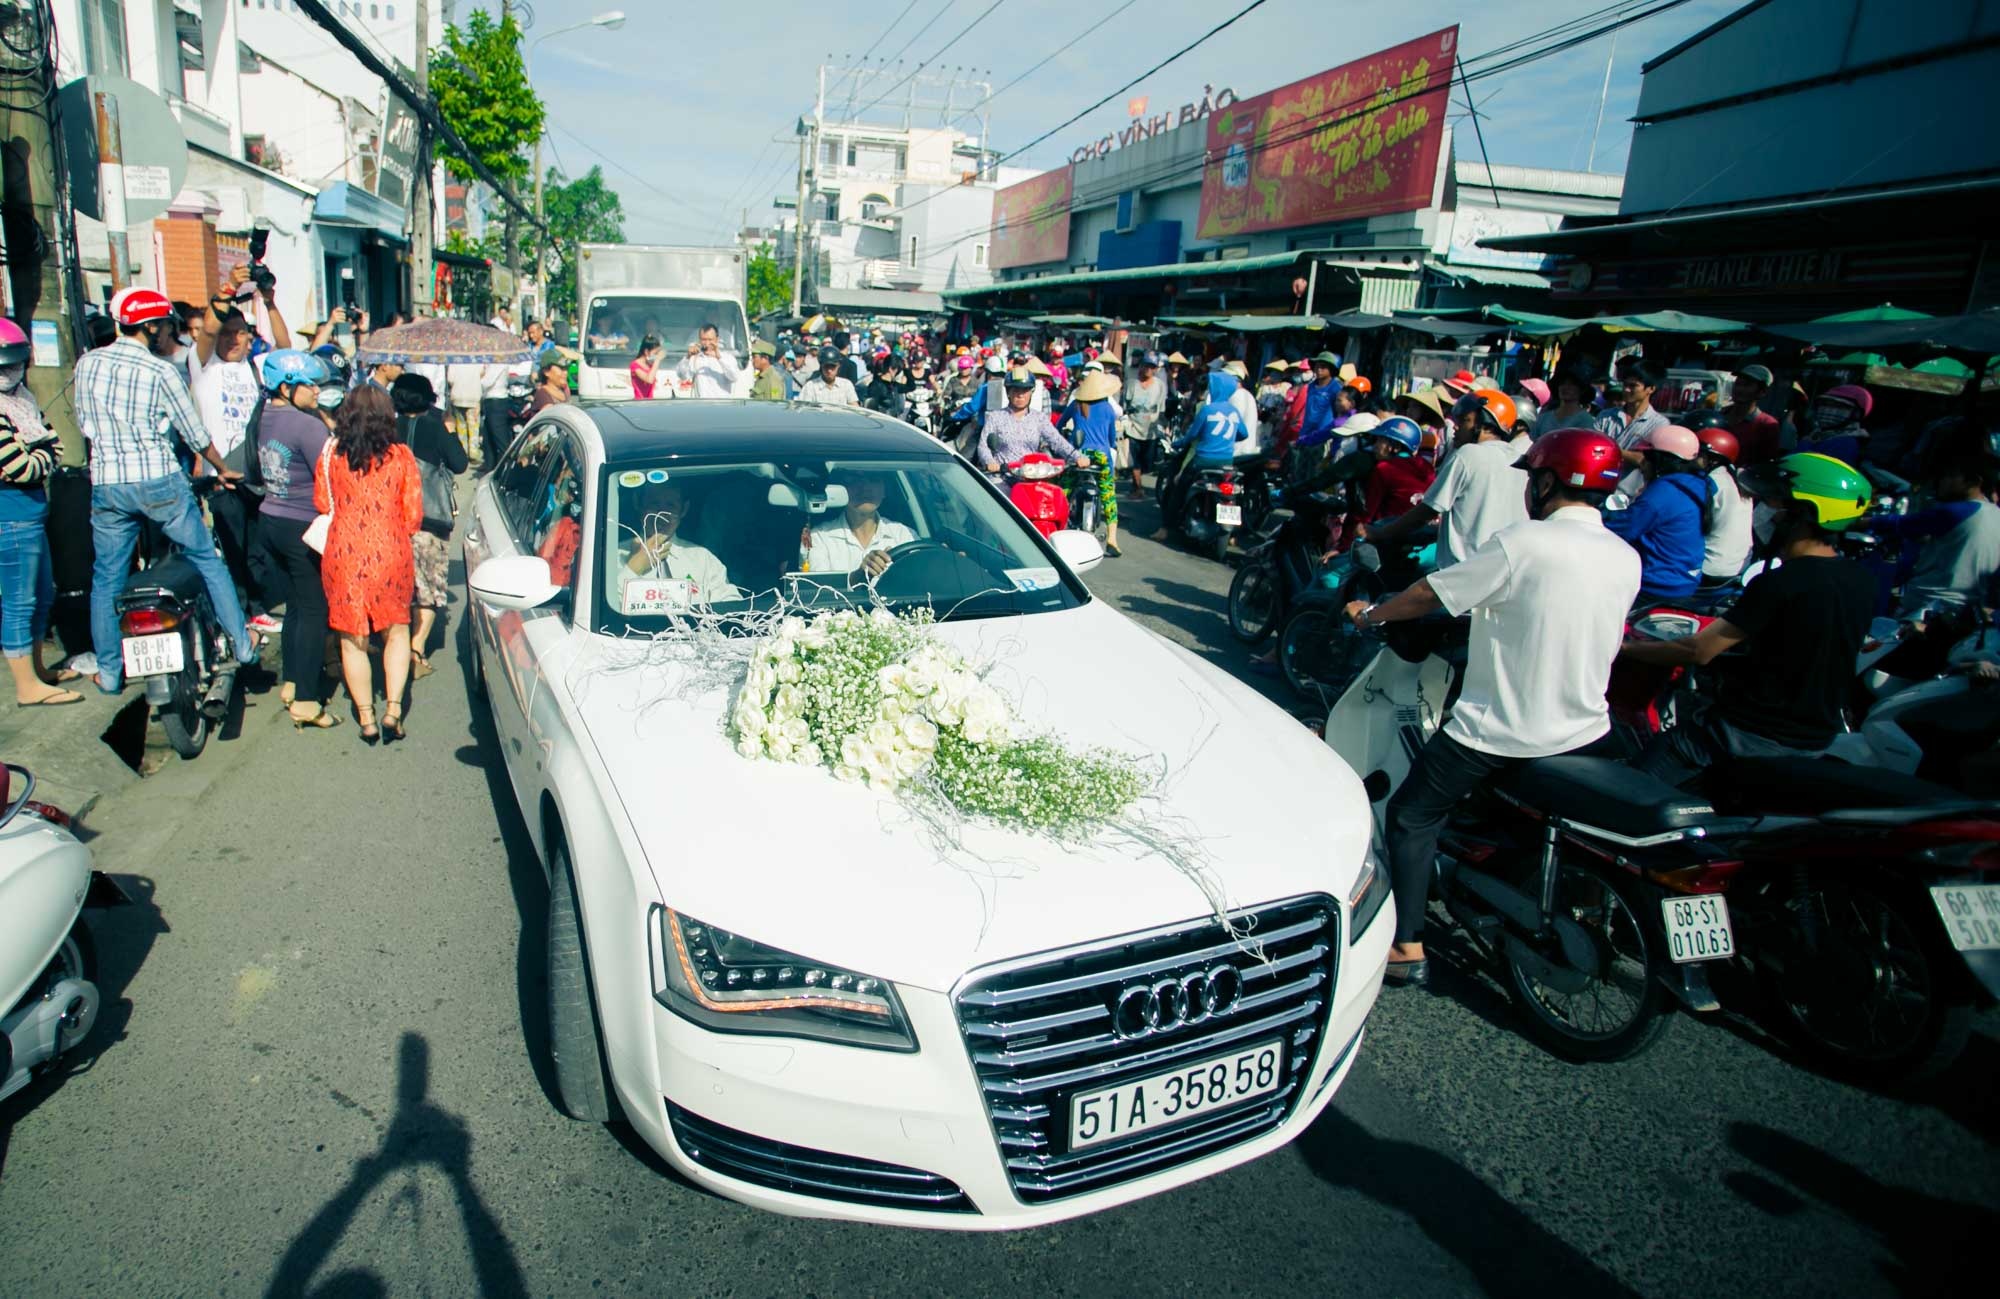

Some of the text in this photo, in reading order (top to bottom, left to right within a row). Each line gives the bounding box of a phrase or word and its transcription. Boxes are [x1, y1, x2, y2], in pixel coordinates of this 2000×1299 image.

[1385, 104, 1430, 148] chia
[1682, 257, 1753, 288] THANH
[133, 637, 171, 656] 68-H1
[135, 654, 173, 673] 1064
[1673, 927, 1730, 958] 010.63
[1079, 1049, 1275, 1140] 51A-358.58
